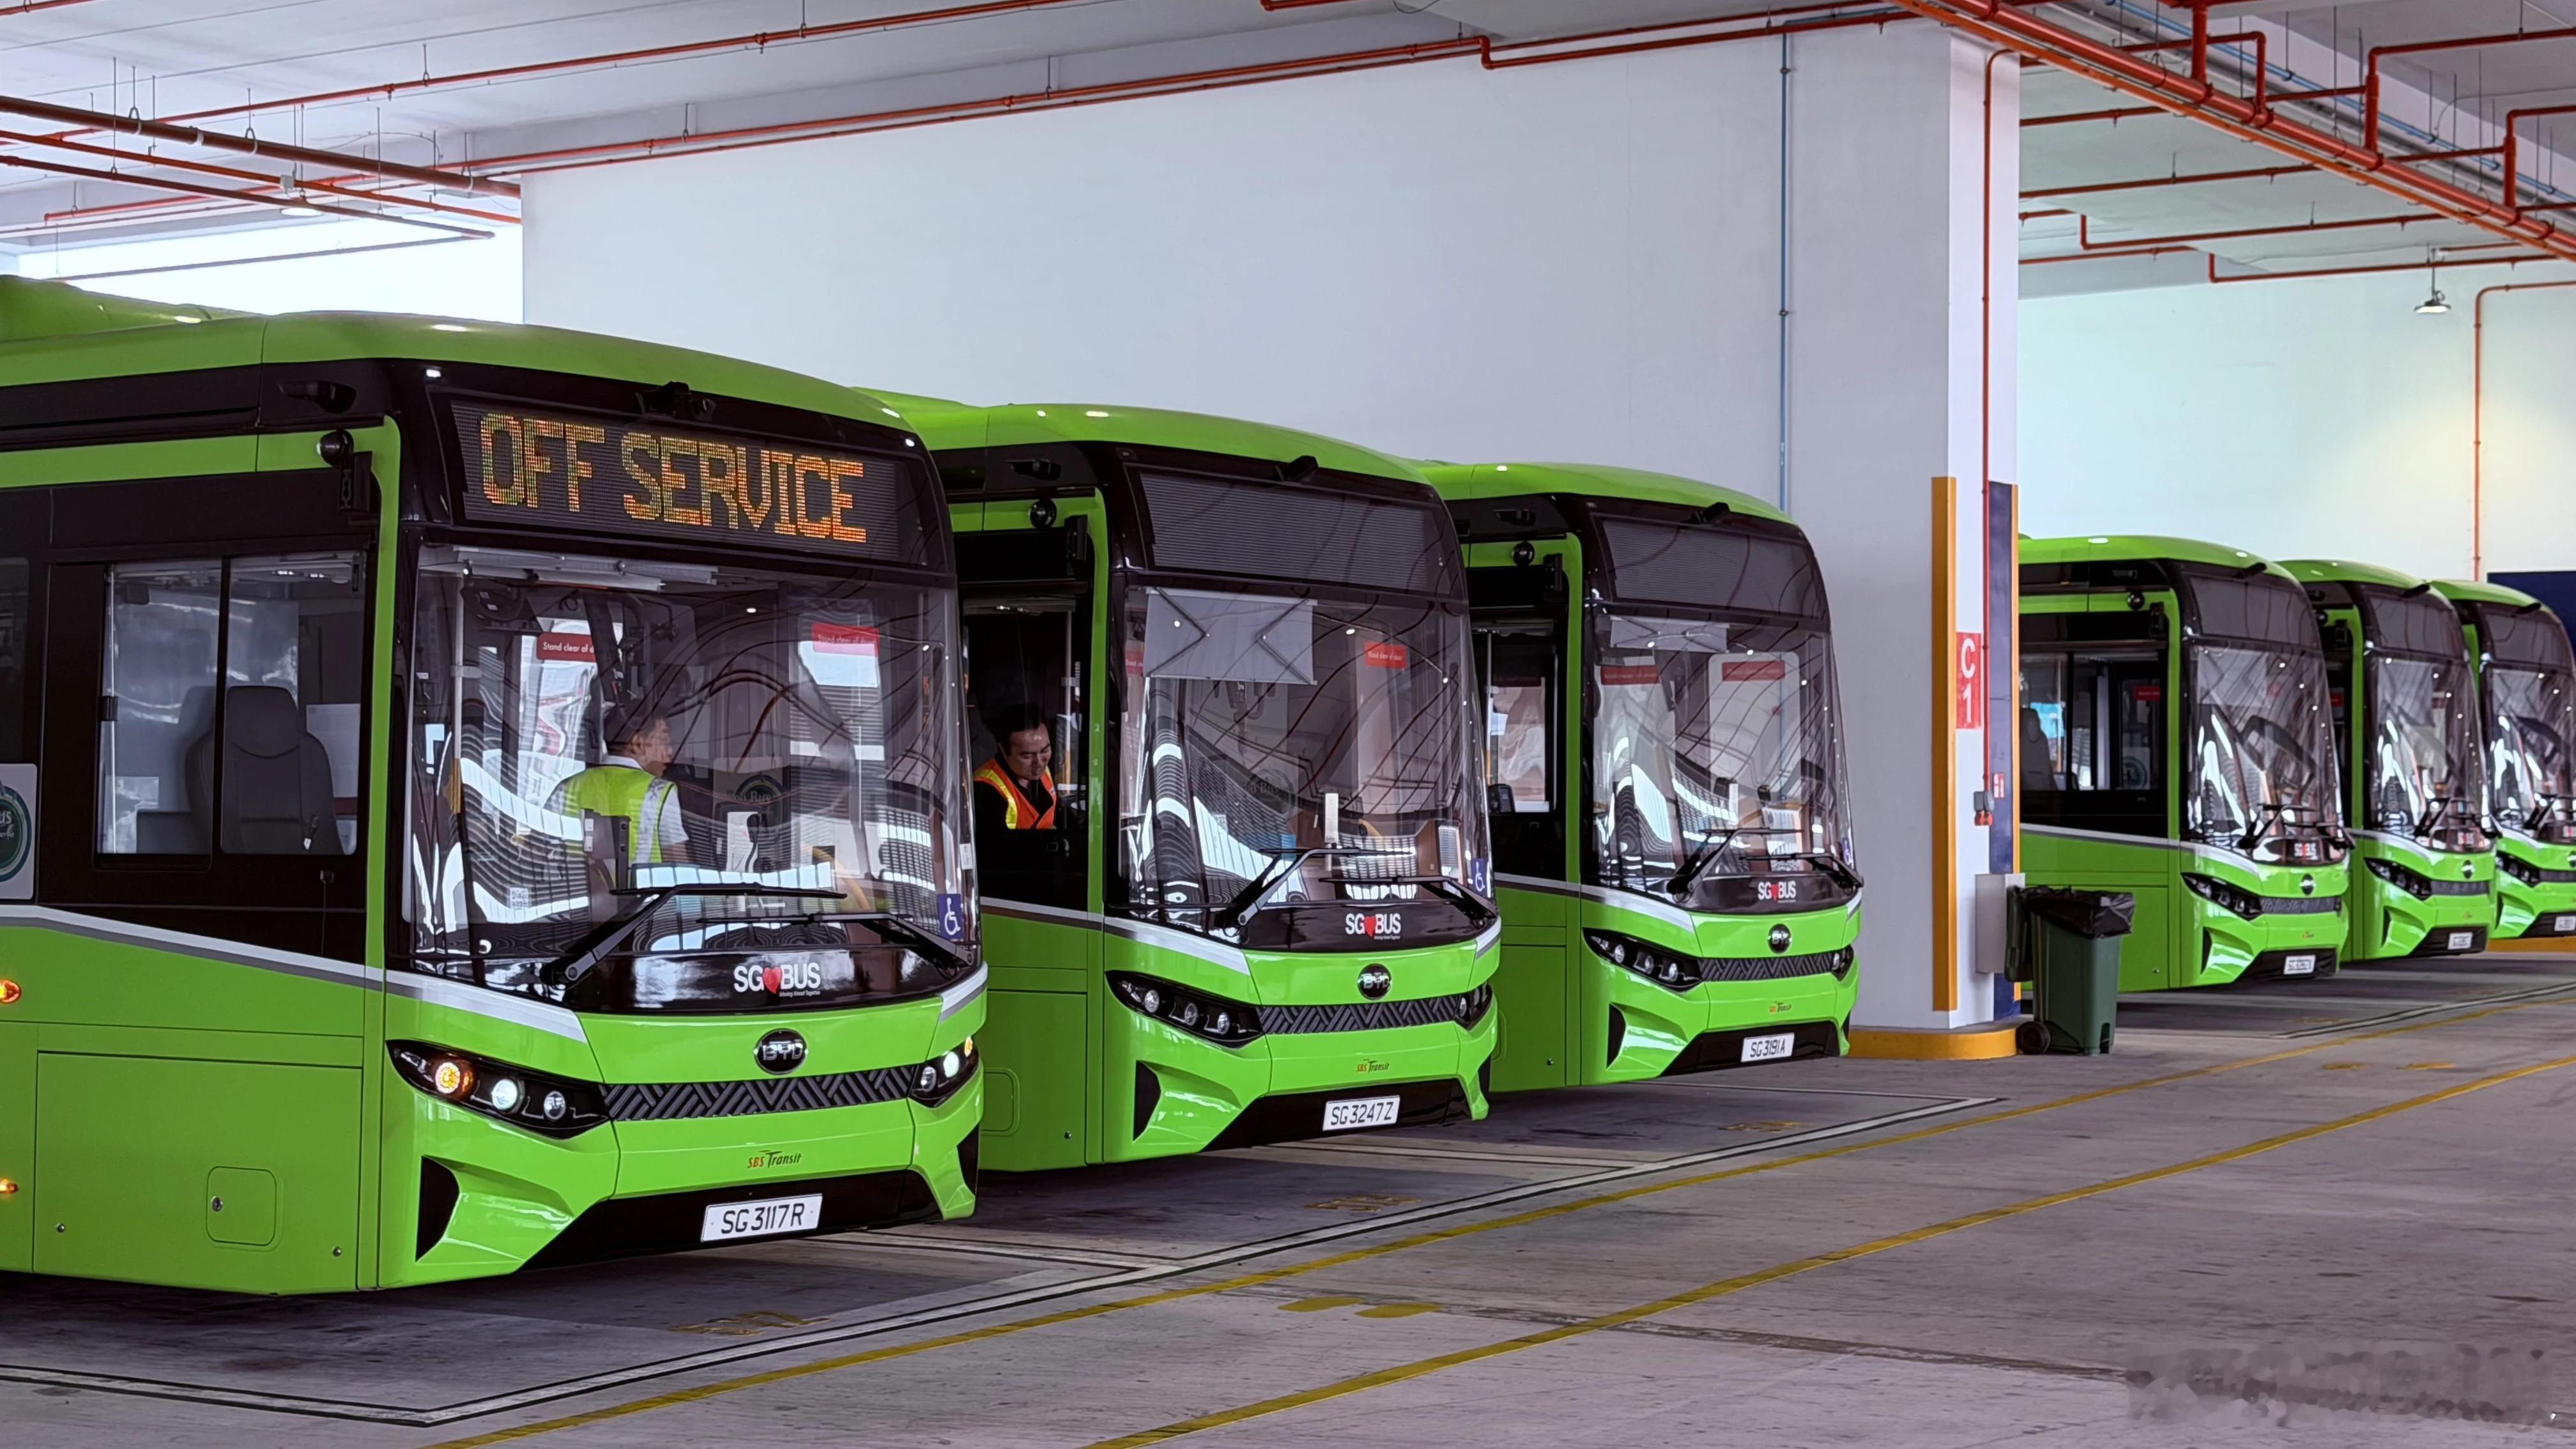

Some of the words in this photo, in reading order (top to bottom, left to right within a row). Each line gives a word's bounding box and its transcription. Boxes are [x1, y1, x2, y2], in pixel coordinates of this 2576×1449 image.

[479, 412, 606, 513] OFF
[621, 431, 867, 543] SERVICE
[543, 641, 562, 651] Stand
[564, 643, 579, 652] clear
[581, 644, 588, 653] of
[1961, 638, 1976, 679] C
[1963, 683, 1972, 724] 1
[1345, 913, 1365, 935] SG
[1375, 913, 1401, 934] BUS
[733, 965, 765, 992] SG
[780, 962, 821, 990] BUS
[762, 1039, 804, 1061] BYD
[747, 1156, 765, 1169] SBS
[765, 1151, 802, 1169] Transit
[721, 1203, 804, 1234] SG3117R
